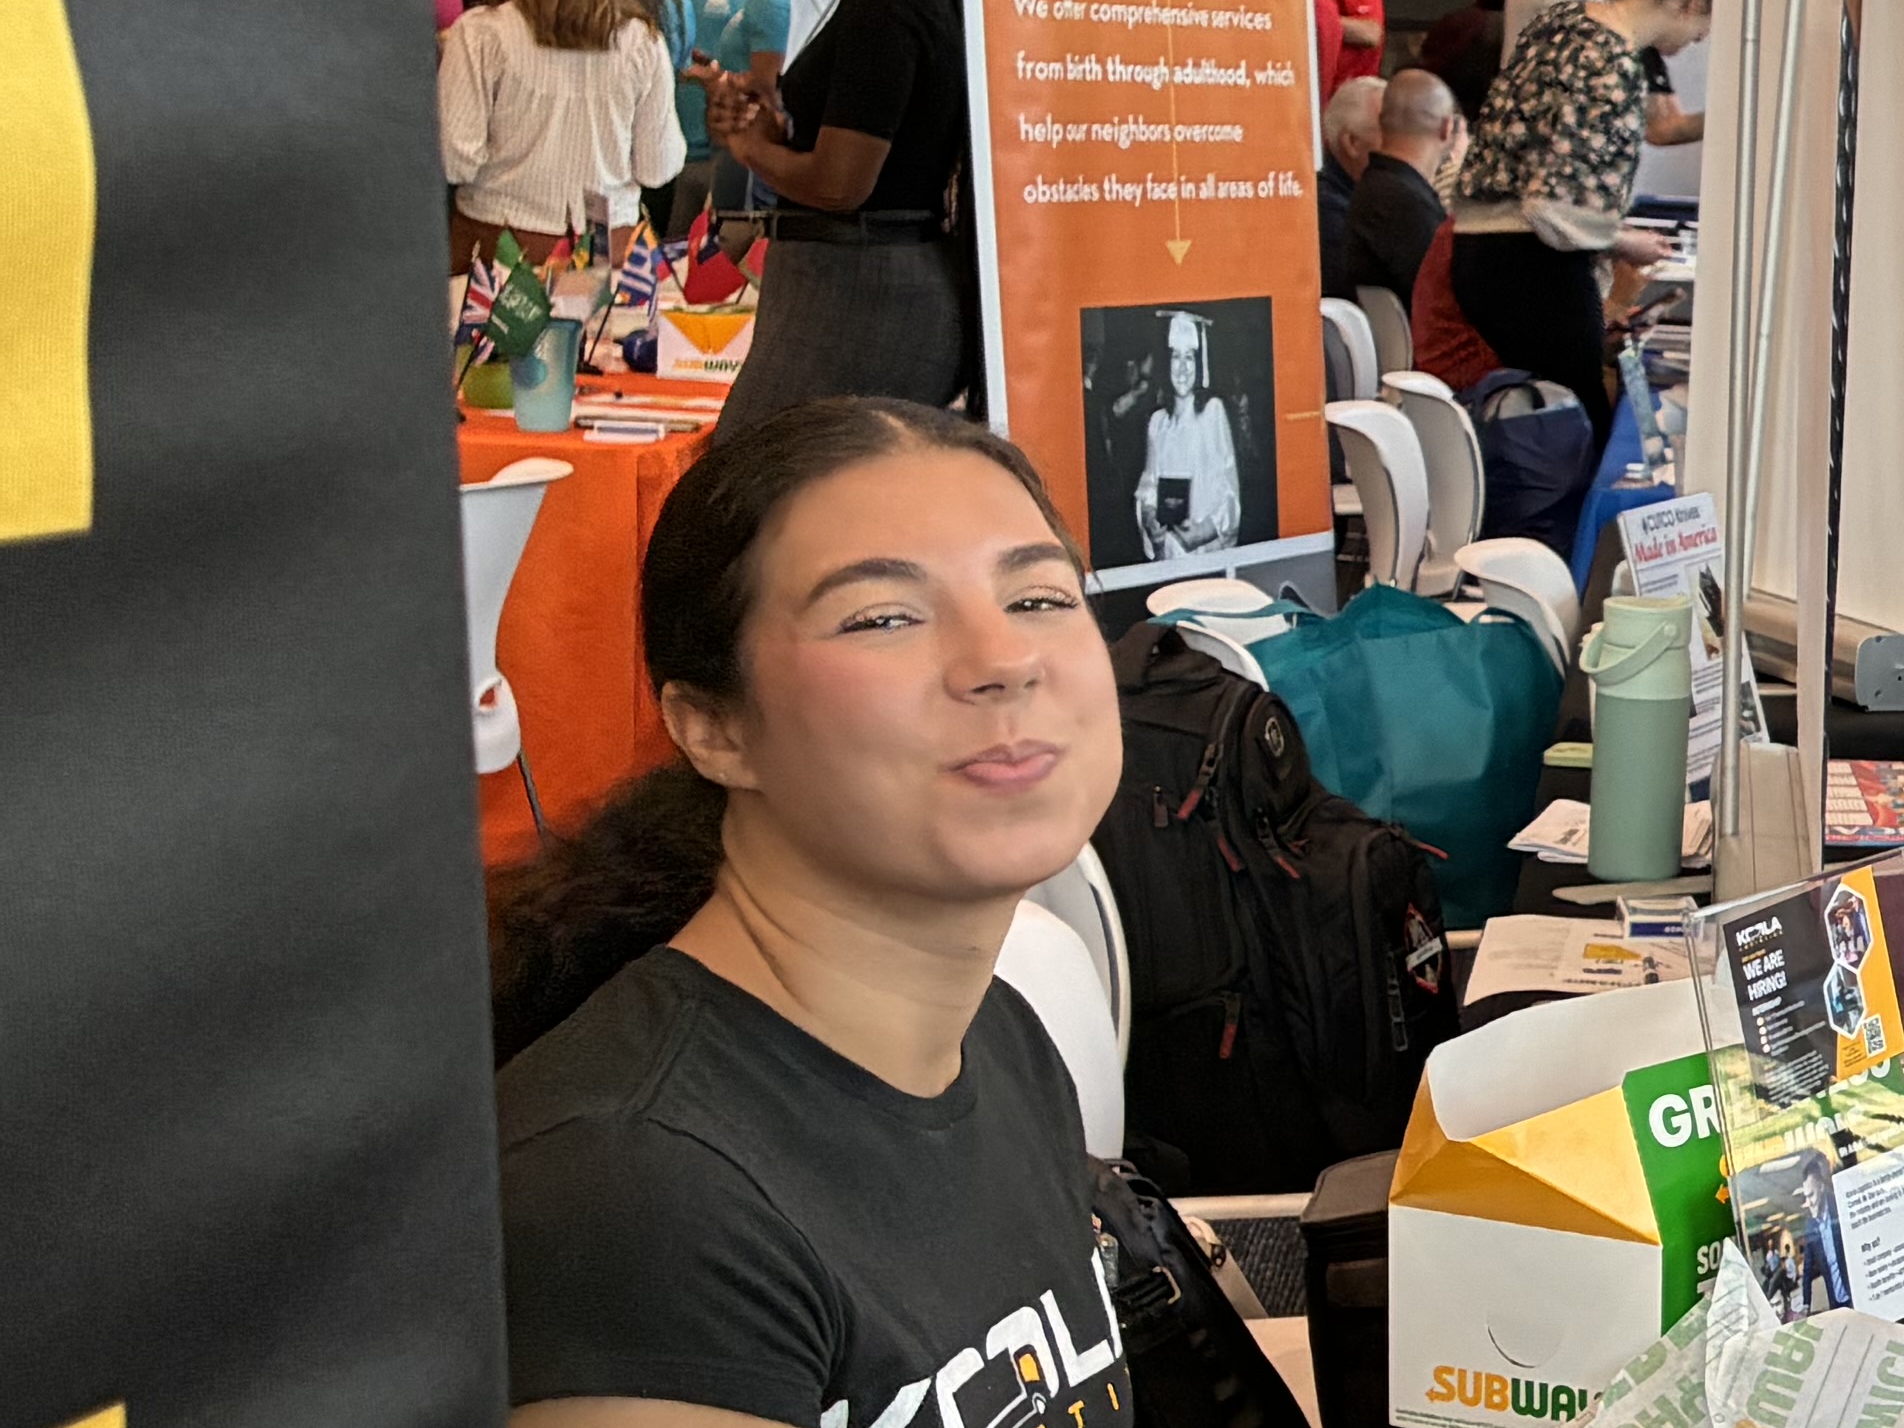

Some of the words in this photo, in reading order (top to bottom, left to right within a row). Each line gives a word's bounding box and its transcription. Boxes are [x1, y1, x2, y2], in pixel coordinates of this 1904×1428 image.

[1211, 5, 1272, 30] services
[1017, 51, 1063, 81] from
[1066, 53, 1102, 82] birth
[1107, 54, 1168, 91] through
[1173, 58, 1251, 88] adulthood,
[1254, 60, 1295, 87] which
[1019, 113, 1062, 149] help
[1067, 122, 1089, 142] our
[1092, 115, 1171, 150] neighbors
[1175, 123, 1244, 142] overcome
[1023, 175, 1099, 204] obstacles
[1104, 173, 1143, 208] they
[1147, 172, 1178, 201] face
[1181, 176, 1196, 200] in
[1200, 173, 1215, 199] all
[1218, 179, 1253, 199] areas
[1257, 172, 1275, 198] of
[1635, 536, 1663, 563] Made
[1678, 523, 1718, 552] America
[1743, 958, 1763, 981] WE
[1763, 949, 1785, 972] ARE
